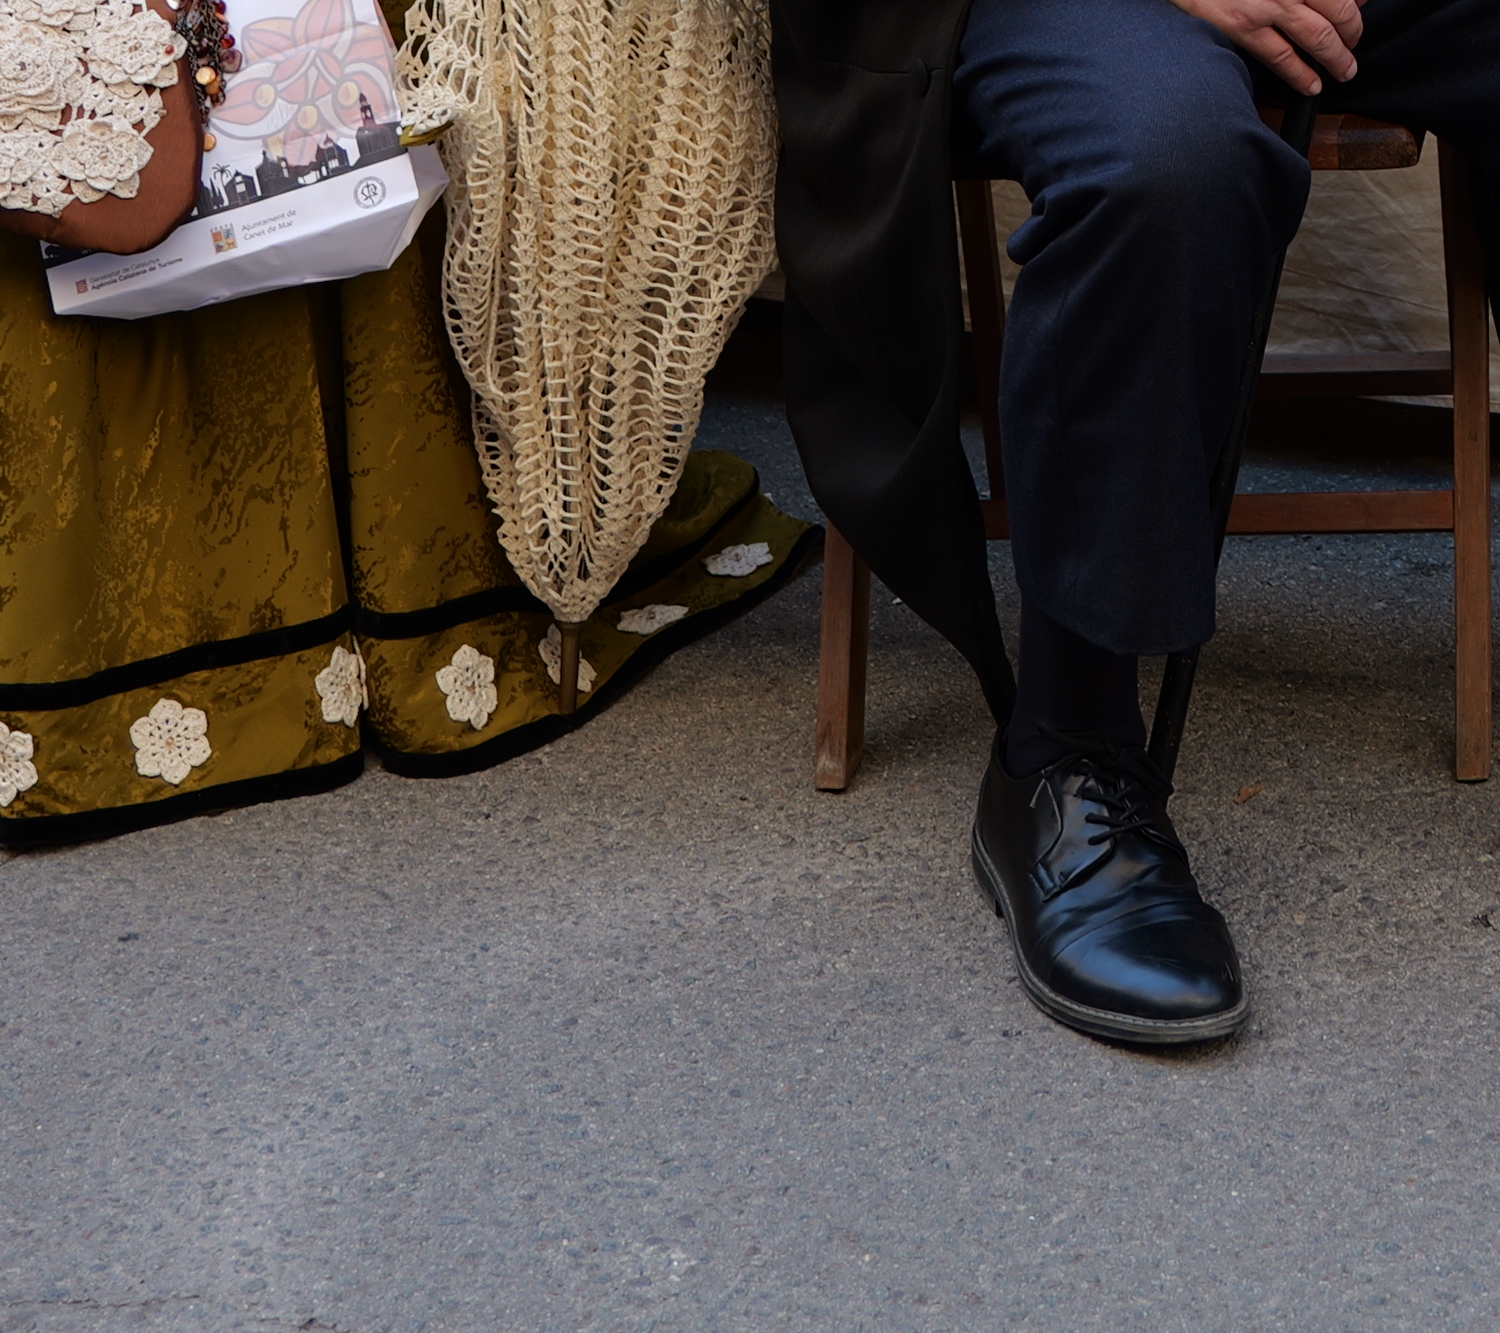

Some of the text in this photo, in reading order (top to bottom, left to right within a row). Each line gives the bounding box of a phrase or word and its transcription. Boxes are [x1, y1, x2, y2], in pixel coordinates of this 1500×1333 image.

[241, 209, 297, 232] Ajuntament de
[243, 228, 266, 241] Canet
[278, 220, 293, 231] Mar
